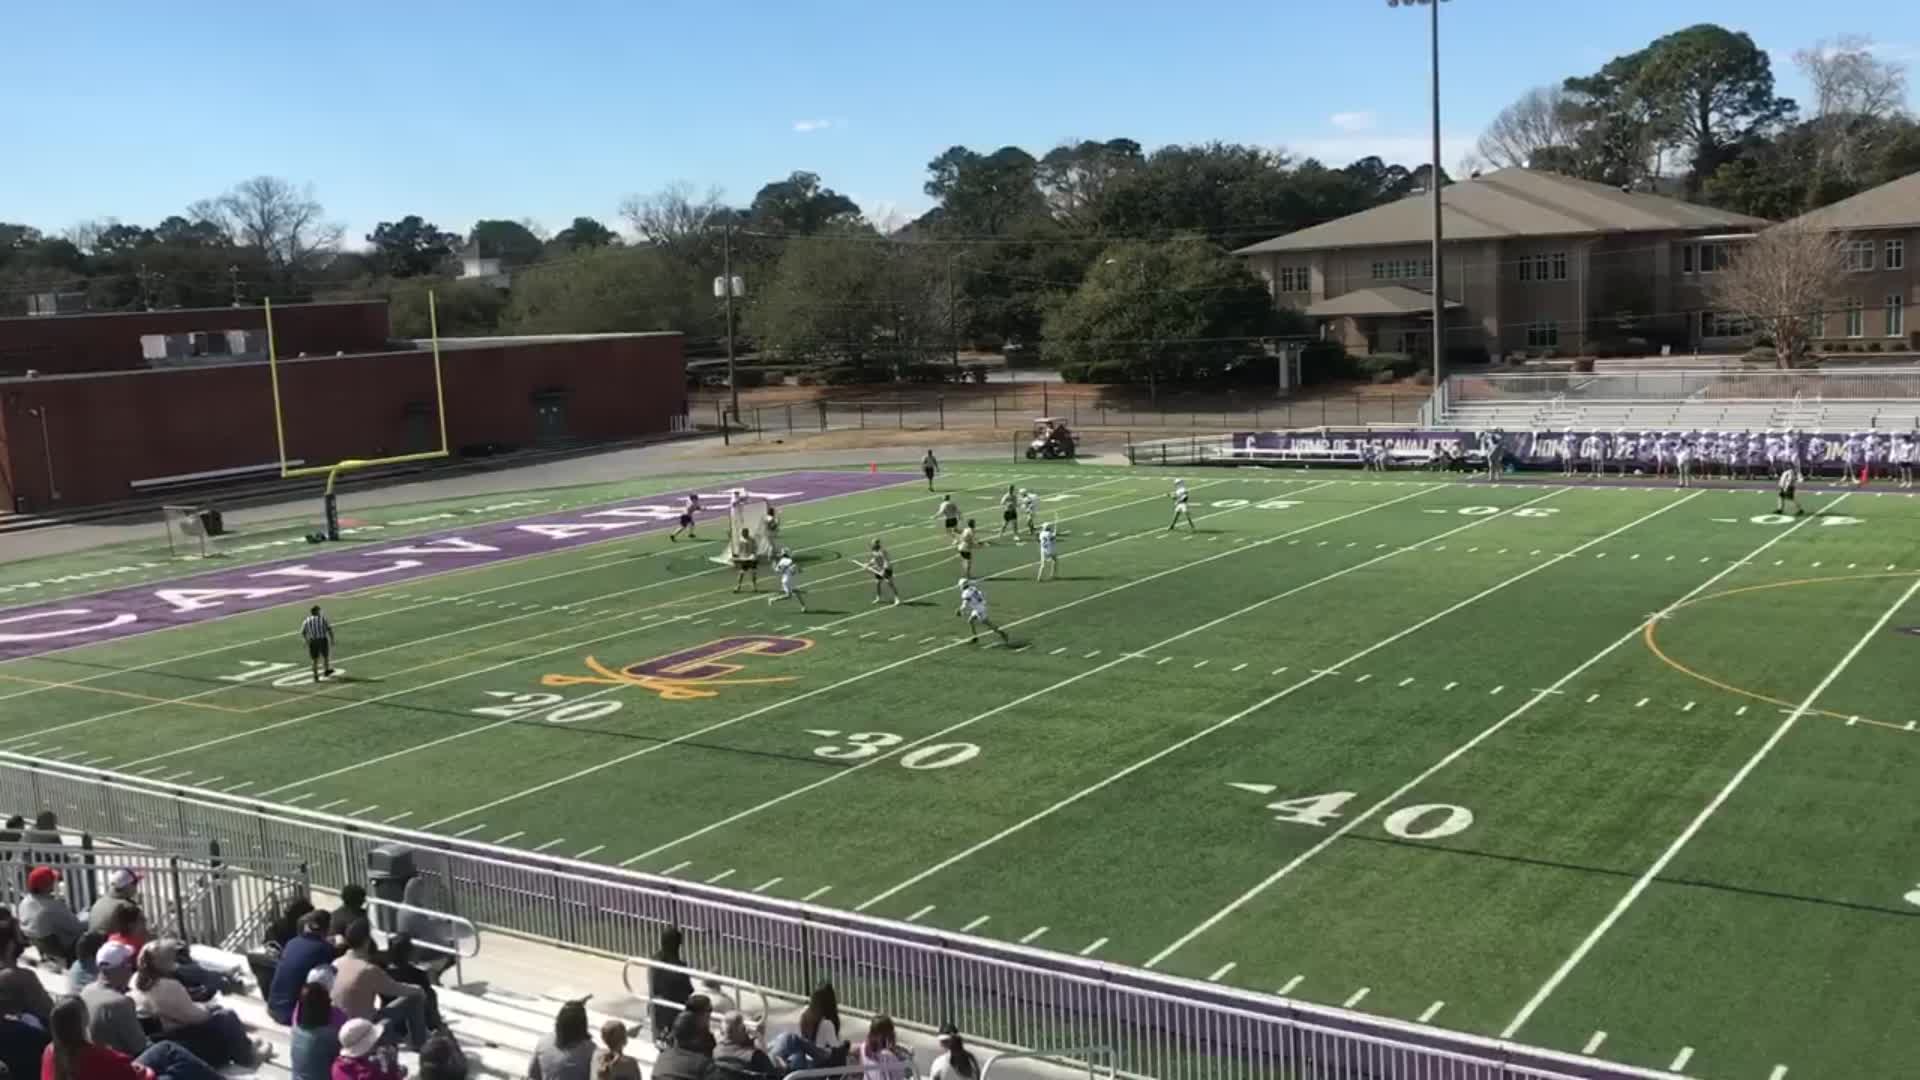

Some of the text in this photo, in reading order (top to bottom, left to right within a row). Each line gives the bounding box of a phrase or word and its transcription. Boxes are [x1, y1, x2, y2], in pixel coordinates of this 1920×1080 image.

[472, 693, 623, 723] 20
[813, 732, 980, 770] 30
[1266, 790, 1474, 839] 40
